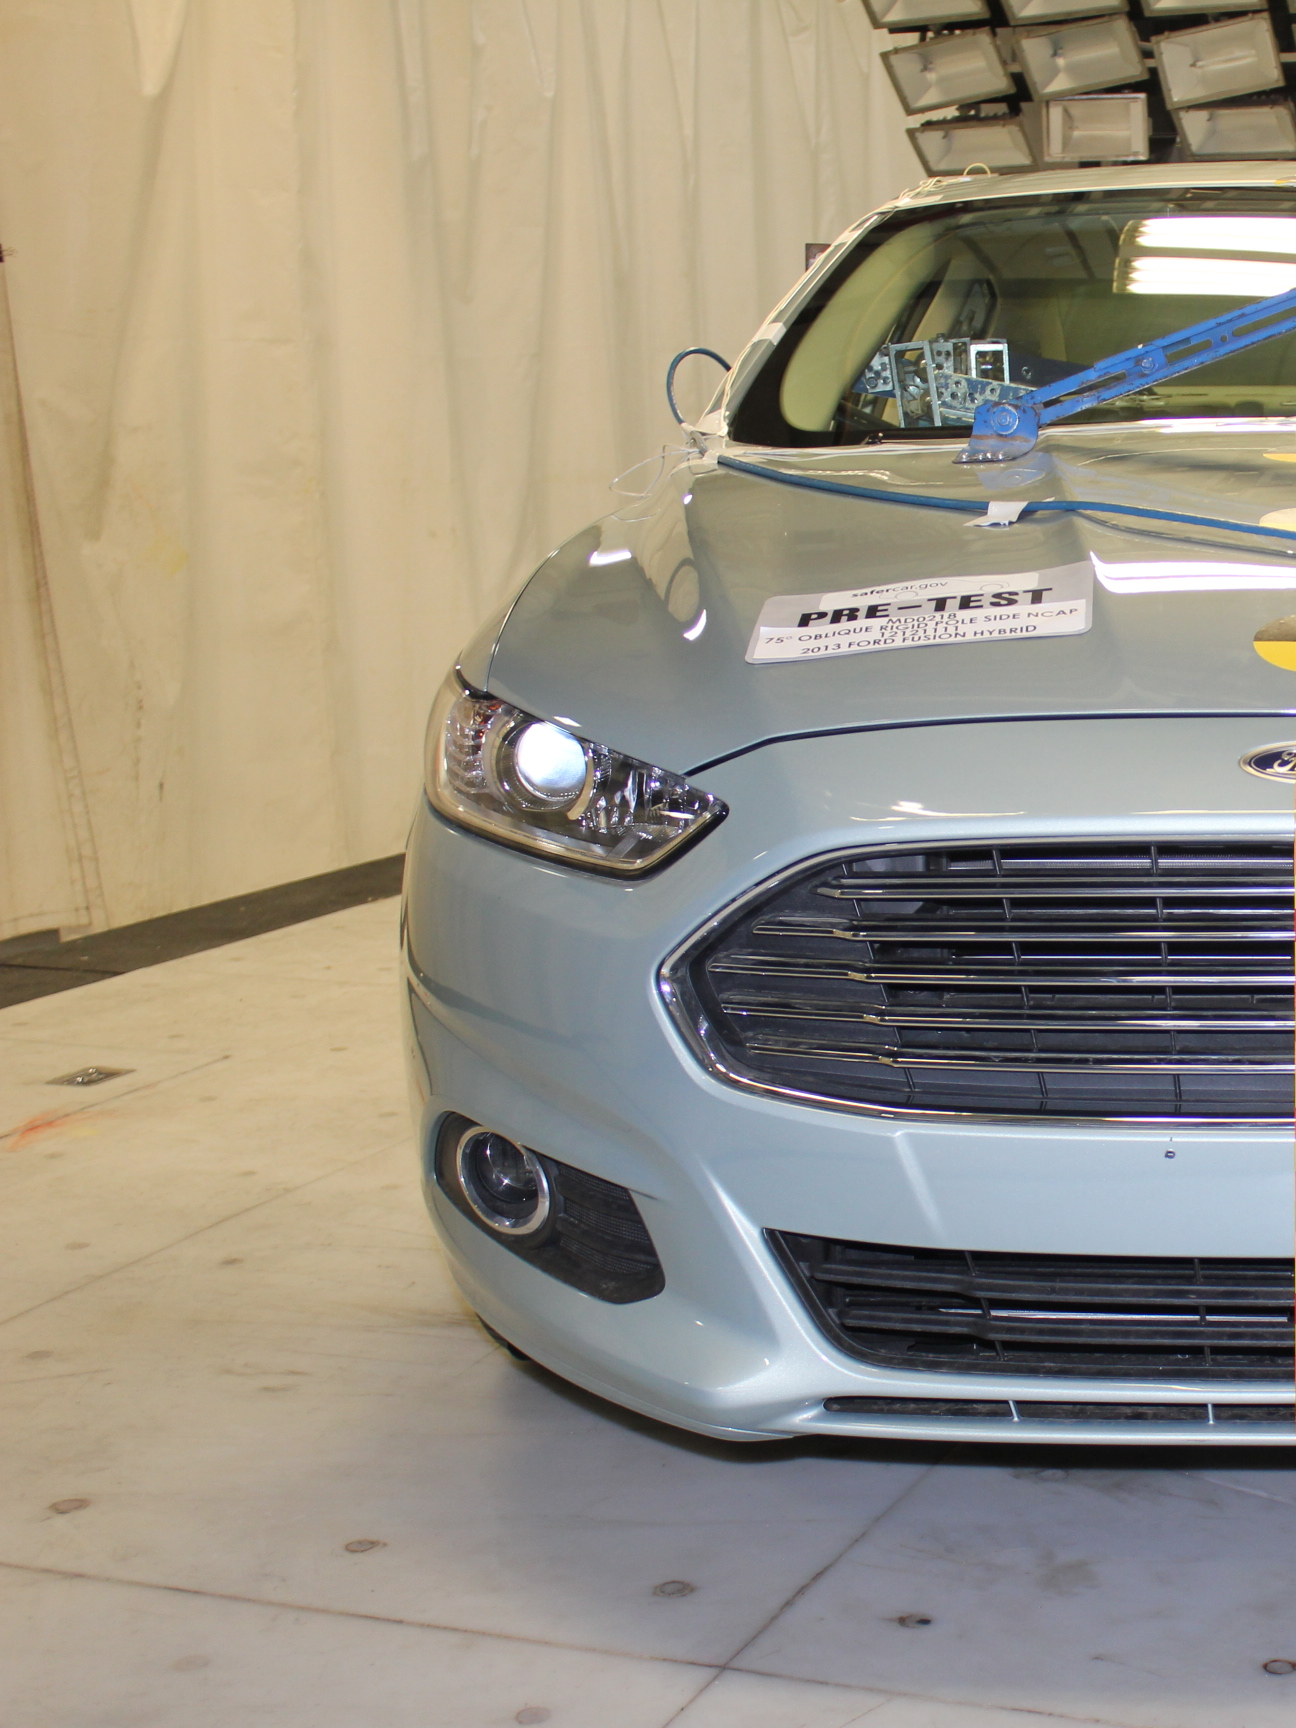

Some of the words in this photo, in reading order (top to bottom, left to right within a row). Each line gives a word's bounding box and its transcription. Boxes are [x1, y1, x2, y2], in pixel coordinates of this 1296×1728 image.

[851, 581, 949, 598] safercar.gov
[797, 587, 1053, 628] PRE-TEST
[886, 613, 957, 625] MD0218
[798, 626, 873, 642] OBLIQUE
[879, 621, 928, 631] RIGID
[935, 617, 977, 626] POLE
[983, 613, 1021, 622] SIDE
[1027, 608, 1078, 618] NCAP
[879, 625, 959, 638] 12121111
[800, 643, 841, 655] 2013
[848, 637, 895, 649] FORD
[902, 632, 966, 643] FUSION
[973, 625, 1037, 637] HYBRID
